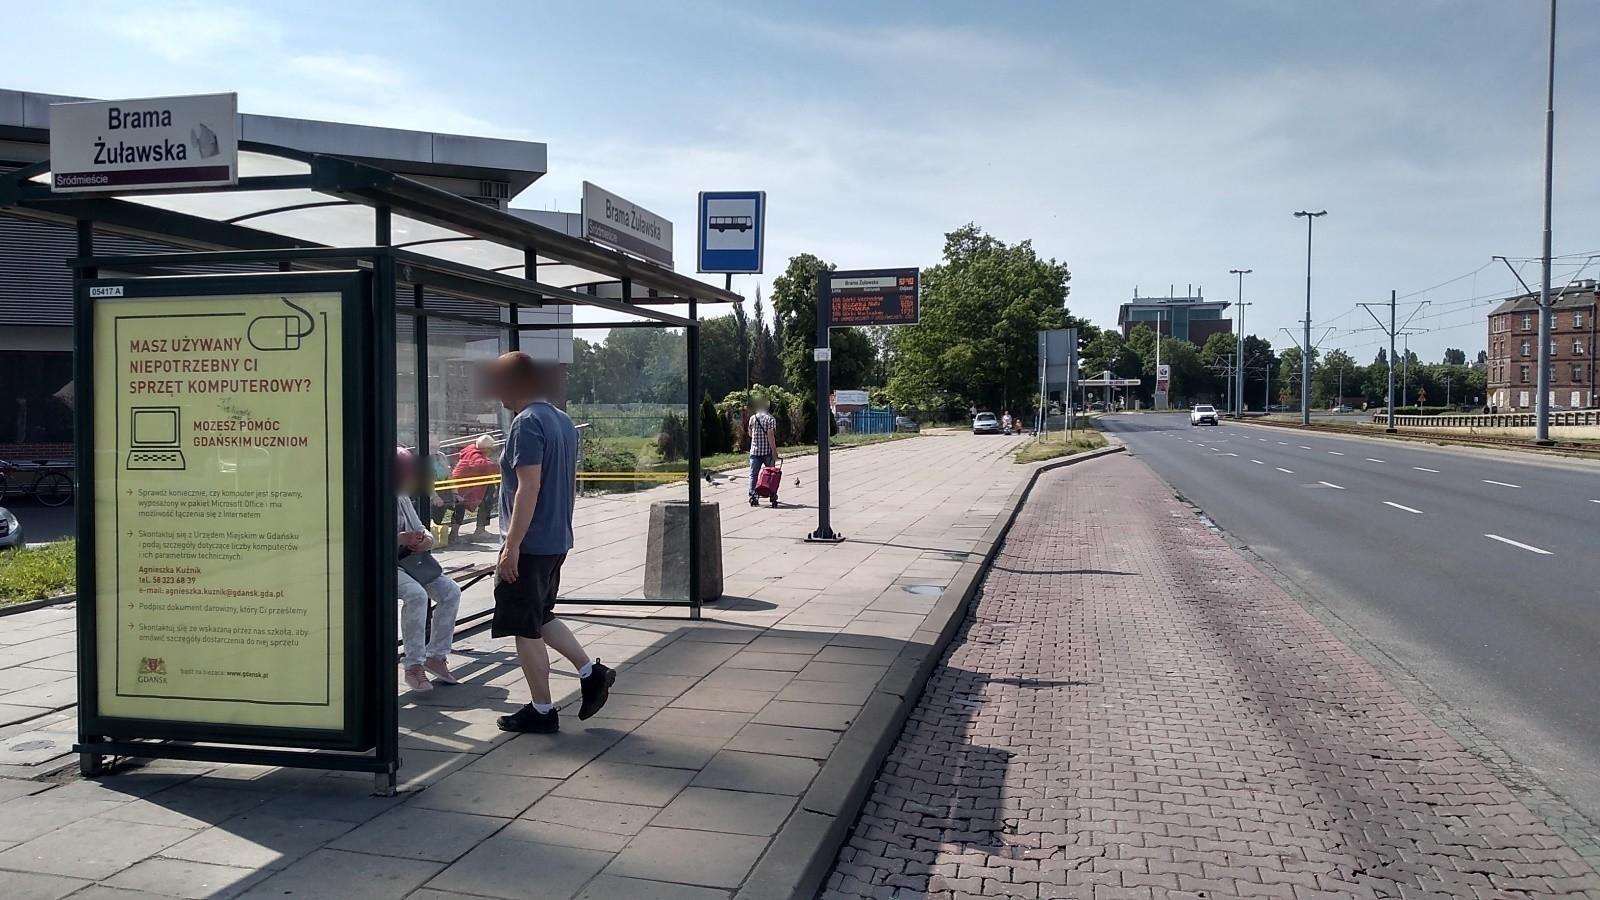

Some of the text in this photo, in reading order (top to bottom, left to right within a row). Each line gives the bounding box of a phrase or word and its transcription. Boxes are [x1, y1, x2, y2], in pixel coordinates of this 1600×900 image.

[108, 107, 172, 130] Brama
[94, 136, 187, 165] Żuławska
[56, 174, 109, 186] Śródmieście
[606, 198, 661, 240] Brama Żuławska
[92, 288, 114, 296] 05417
[130, 336, 242, 352] MASZ UŻYWANY
[130, 359, 258, 373] NIEPOTRZEBNY CI
[130, 378, 312, 398] SPRZĘT KOMPUTEROWY?
[240, 418, 280, 431] POMÓC
[194, 433, 308, 447] GDAŃSKIM UCZNIOM
[222, 490, 254, 499] komputer
[138, 530, 174, 539] Skontaktuj
[232, 543, 251, 551] liczby
[253, 543, 298, 552] komputerów
[138, 566, 174, 574] Agnieszka
[139, 624, 175, 633] Skontaktuj
[233, 628, 252, 636] przez
[296, 629, 308, 638] aby
